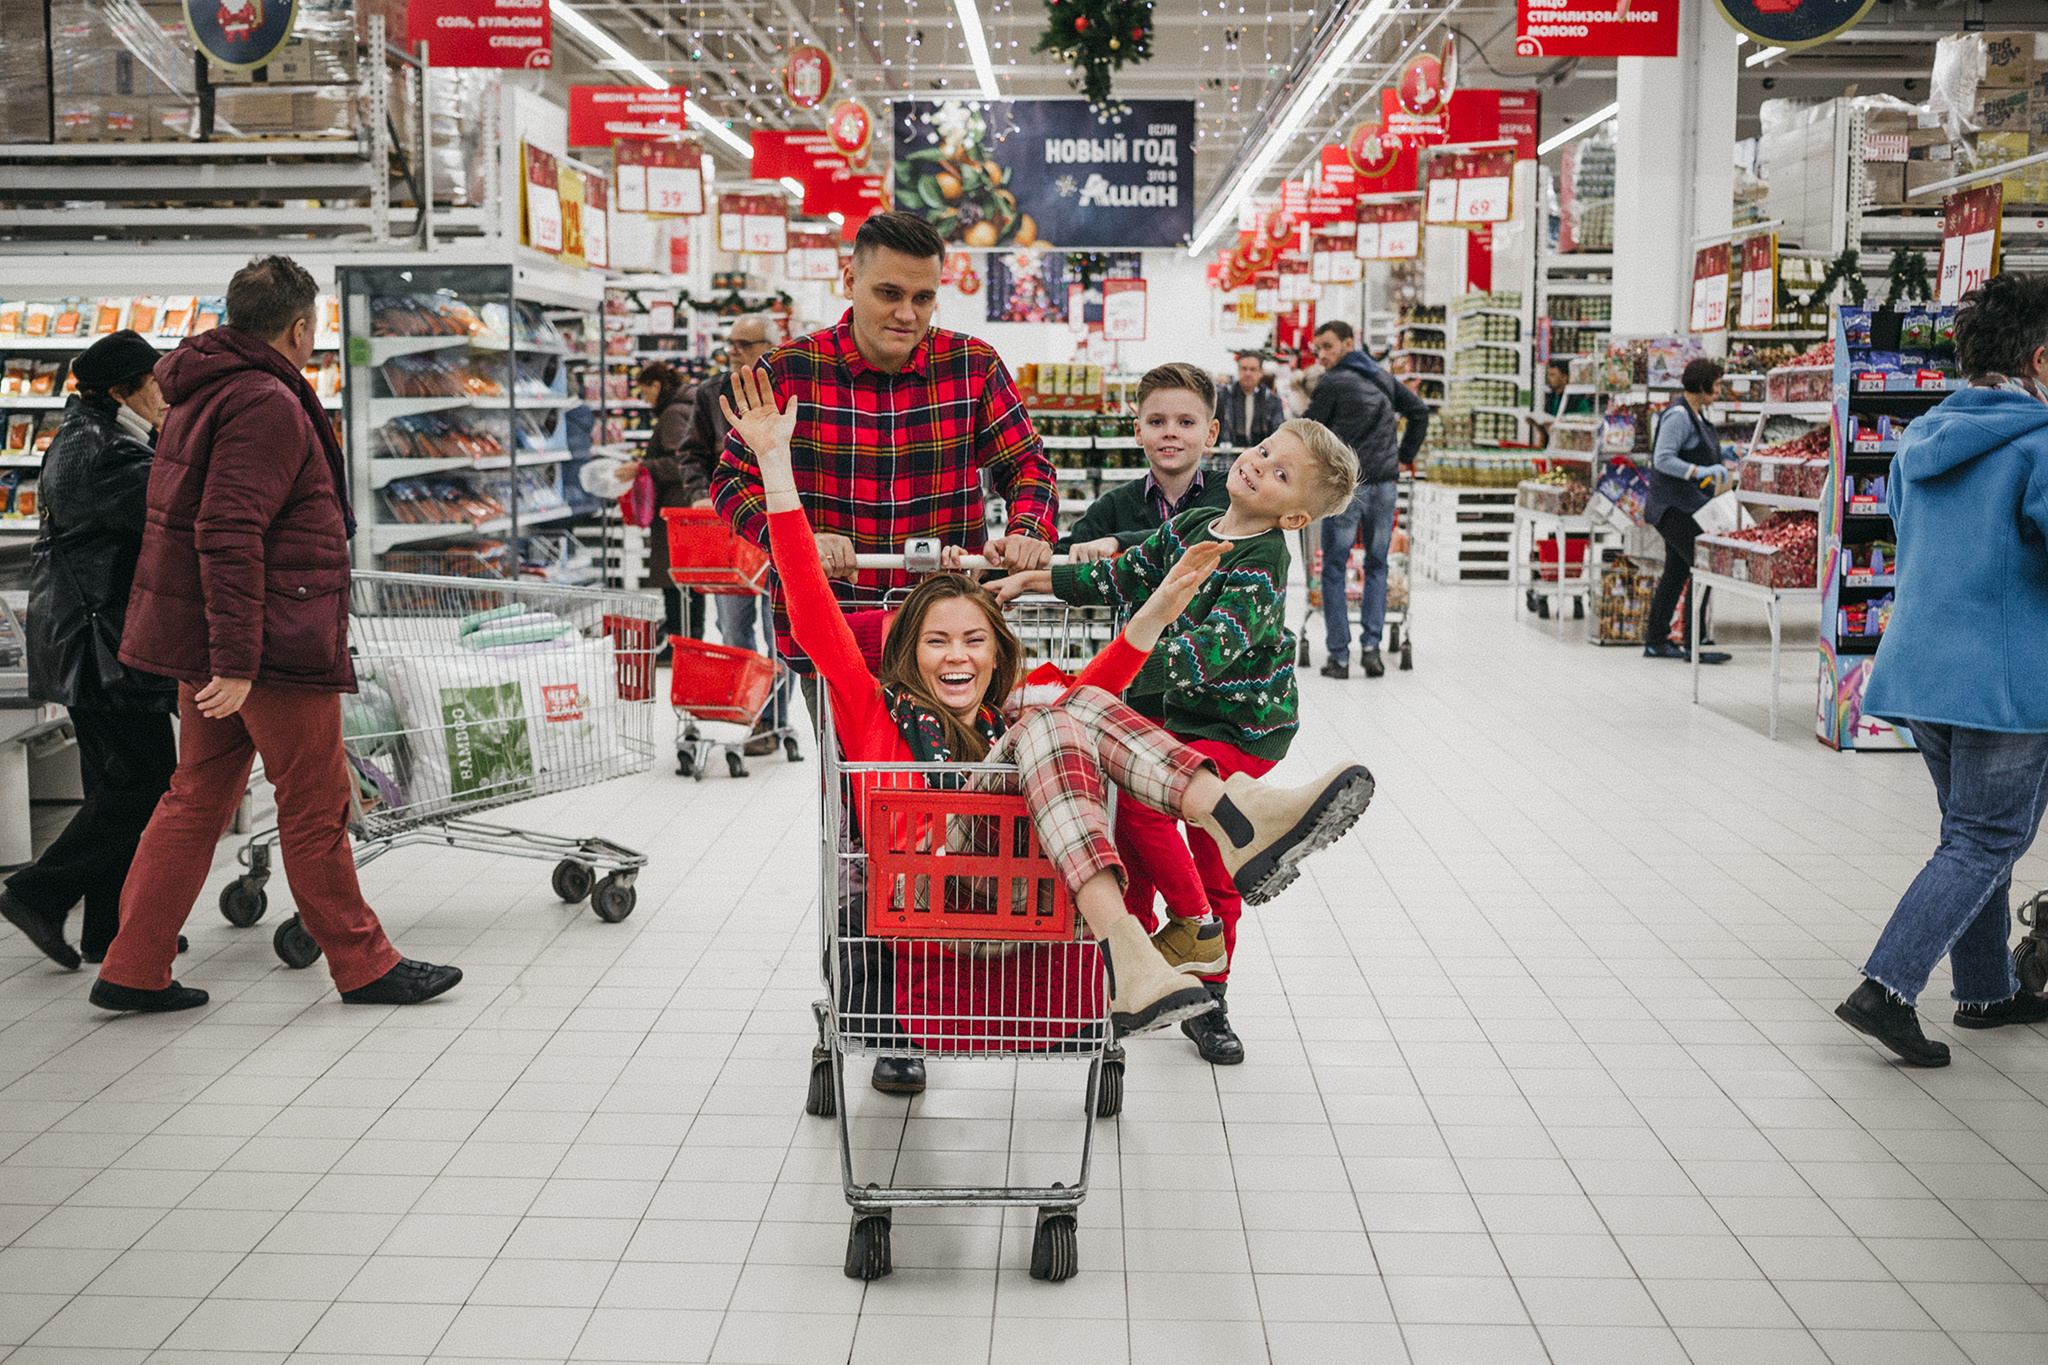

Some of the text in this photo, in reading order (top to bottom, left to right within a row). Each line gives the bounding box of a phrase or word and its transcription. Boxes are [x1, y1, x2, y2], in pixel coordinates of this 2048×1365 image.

[478, 16, 543, 28] БУЛЬОНЫ
[1527, 25, 1588, 37] МОЛОКО
[489, 36, 543, 48] СПЕЦИИ
[1988, 37, 2012, 54] BIG
[1148, 123, 1177, 136] ЕСЛИ
[1045, 133, 1179, 167] НОВЫЙ ГОД
[1147, 170, 1178, 183] ЭТО В
[1078, 173, 1179, 208] Ашан
[1469, 200, 1490, 216] 69
[452, 708, 473, 779] BAMBOO
